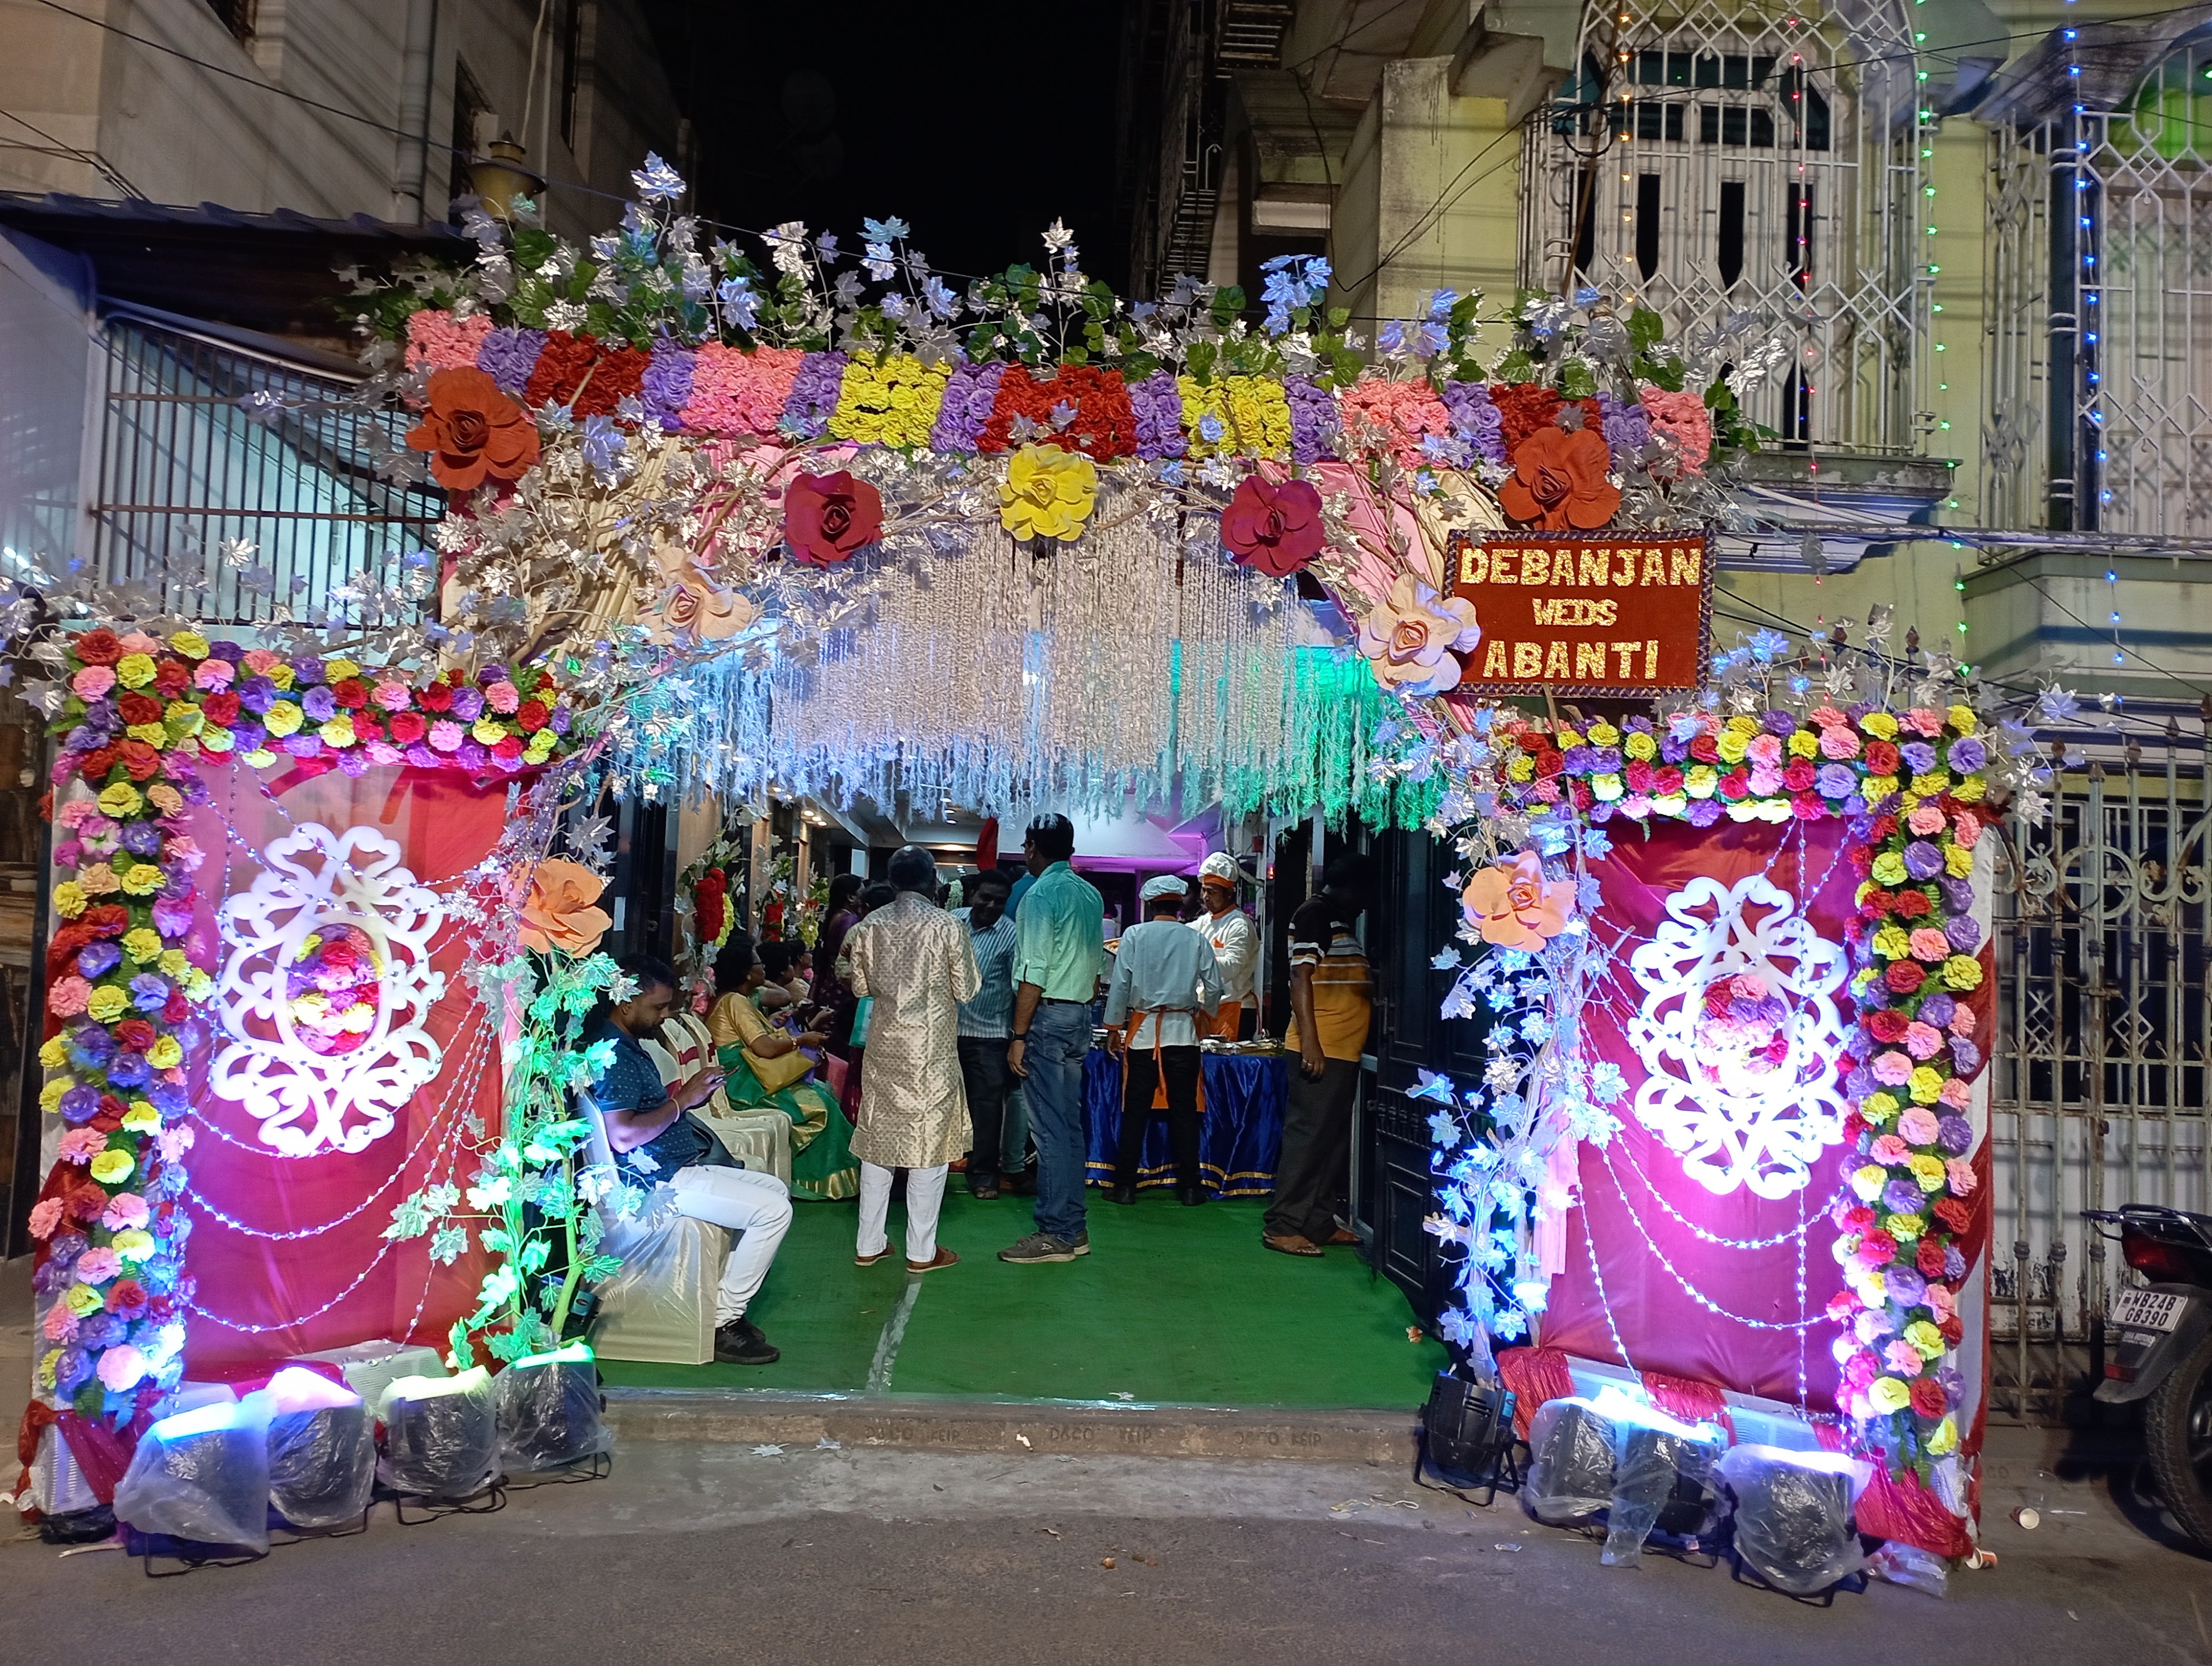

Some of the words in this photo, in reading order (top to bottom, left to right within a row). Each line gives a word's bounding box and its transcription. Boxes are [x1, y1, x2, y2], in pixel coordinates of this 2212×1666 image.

[1460, 548, 1702, 586] DEBANJAN
[1532, 598, 1618, 626] WEDS
[1482, 640, 1658, 680] ABANTI
[2133, 1291, 2176, 1311] WB24B
[2125, 1307, 2169, 1327] G8390
